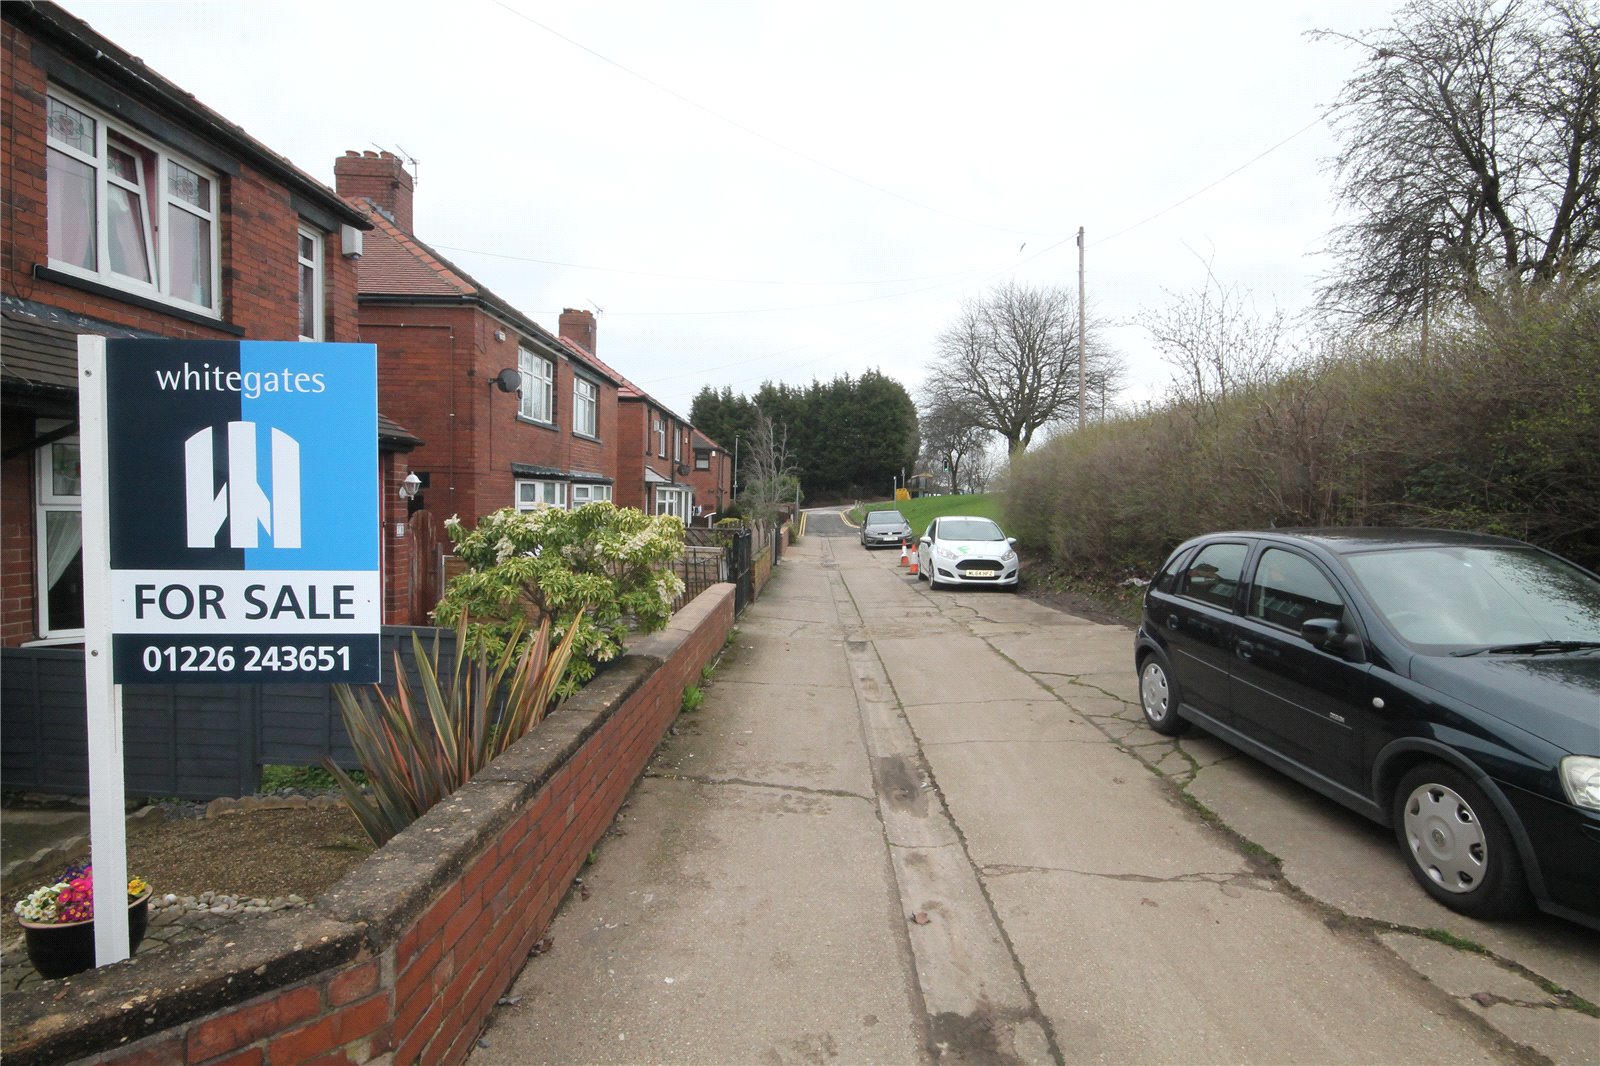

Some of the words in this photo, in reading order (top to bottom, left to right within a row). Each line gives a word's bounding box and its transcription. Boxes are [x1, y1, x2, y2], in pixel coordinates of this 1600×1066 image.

[155, 362, 326, 399] whitegates
[134, 583, 227, 620] FOR
[243, 584, 355, 620] SALE
[142, 645, 236, 672] 01226
[243, 645, 351, 672] 243651
